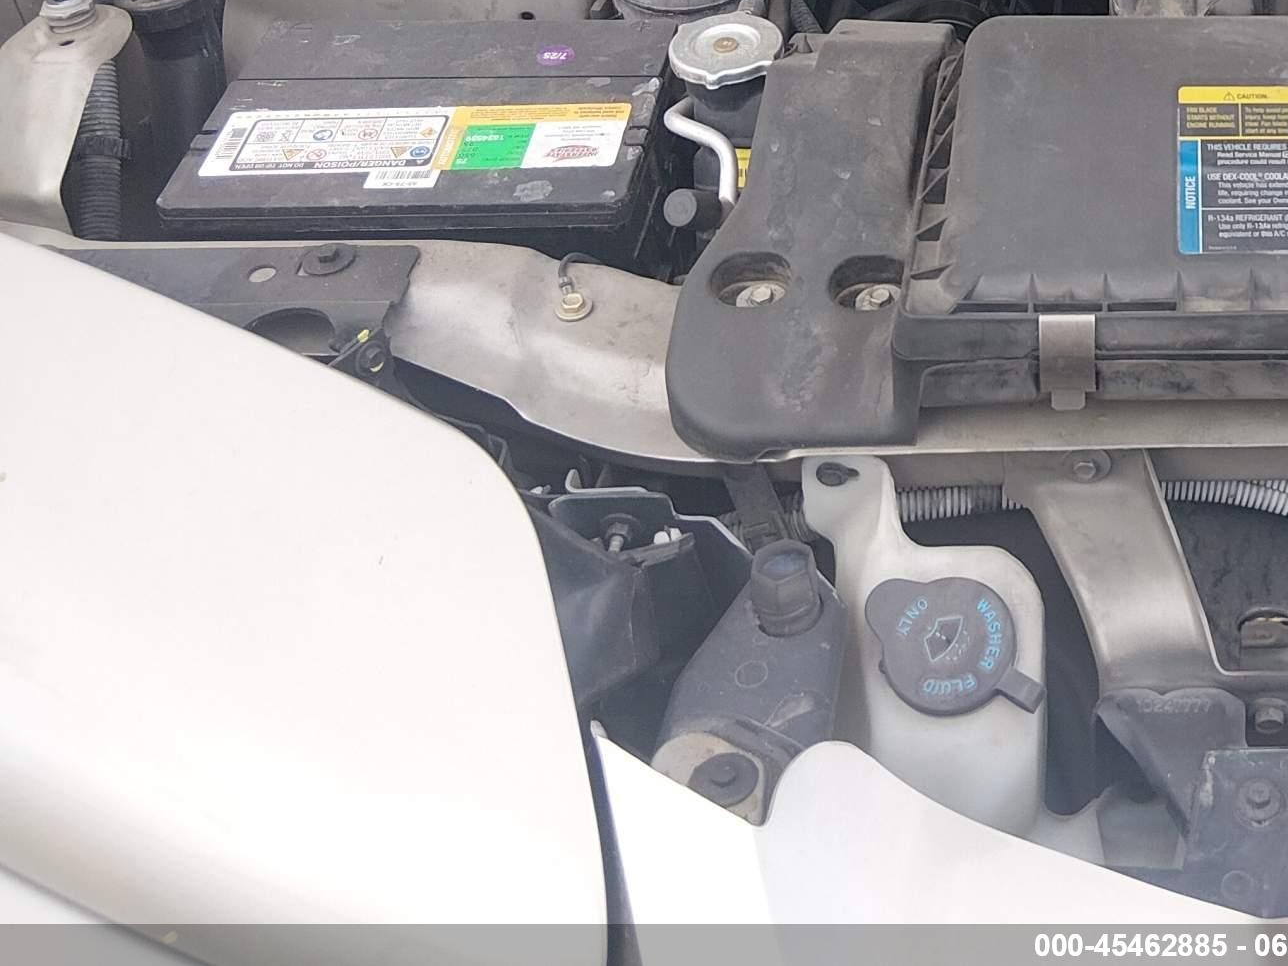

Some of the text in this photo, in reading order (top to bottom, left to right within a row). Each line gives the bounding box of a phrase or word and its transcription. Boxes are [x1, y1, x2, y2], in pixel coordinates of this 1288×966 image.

[1207, 143, 1223, 151] THIS
[1223, 143, 1251, 151] VEHICLE
[1252, 143, 1287, 151] REQUIRES
[544, 151, 600, 159] INTERSTATE
[277, 162, 291, 170] NOT
[292, 162, 305, 170] DO
[313, 159, 407, 169] DANGER/POISON
[1207, 172, 1222, 181] USE
[1185, 176, 1196, 209] NOTICE
[1207, 214, 1234, 222] R-134a
[1235, 214, 1283, 222] REFRIGERANT
[896, 598, 1001, 692] WASHER FLUID ONLY
